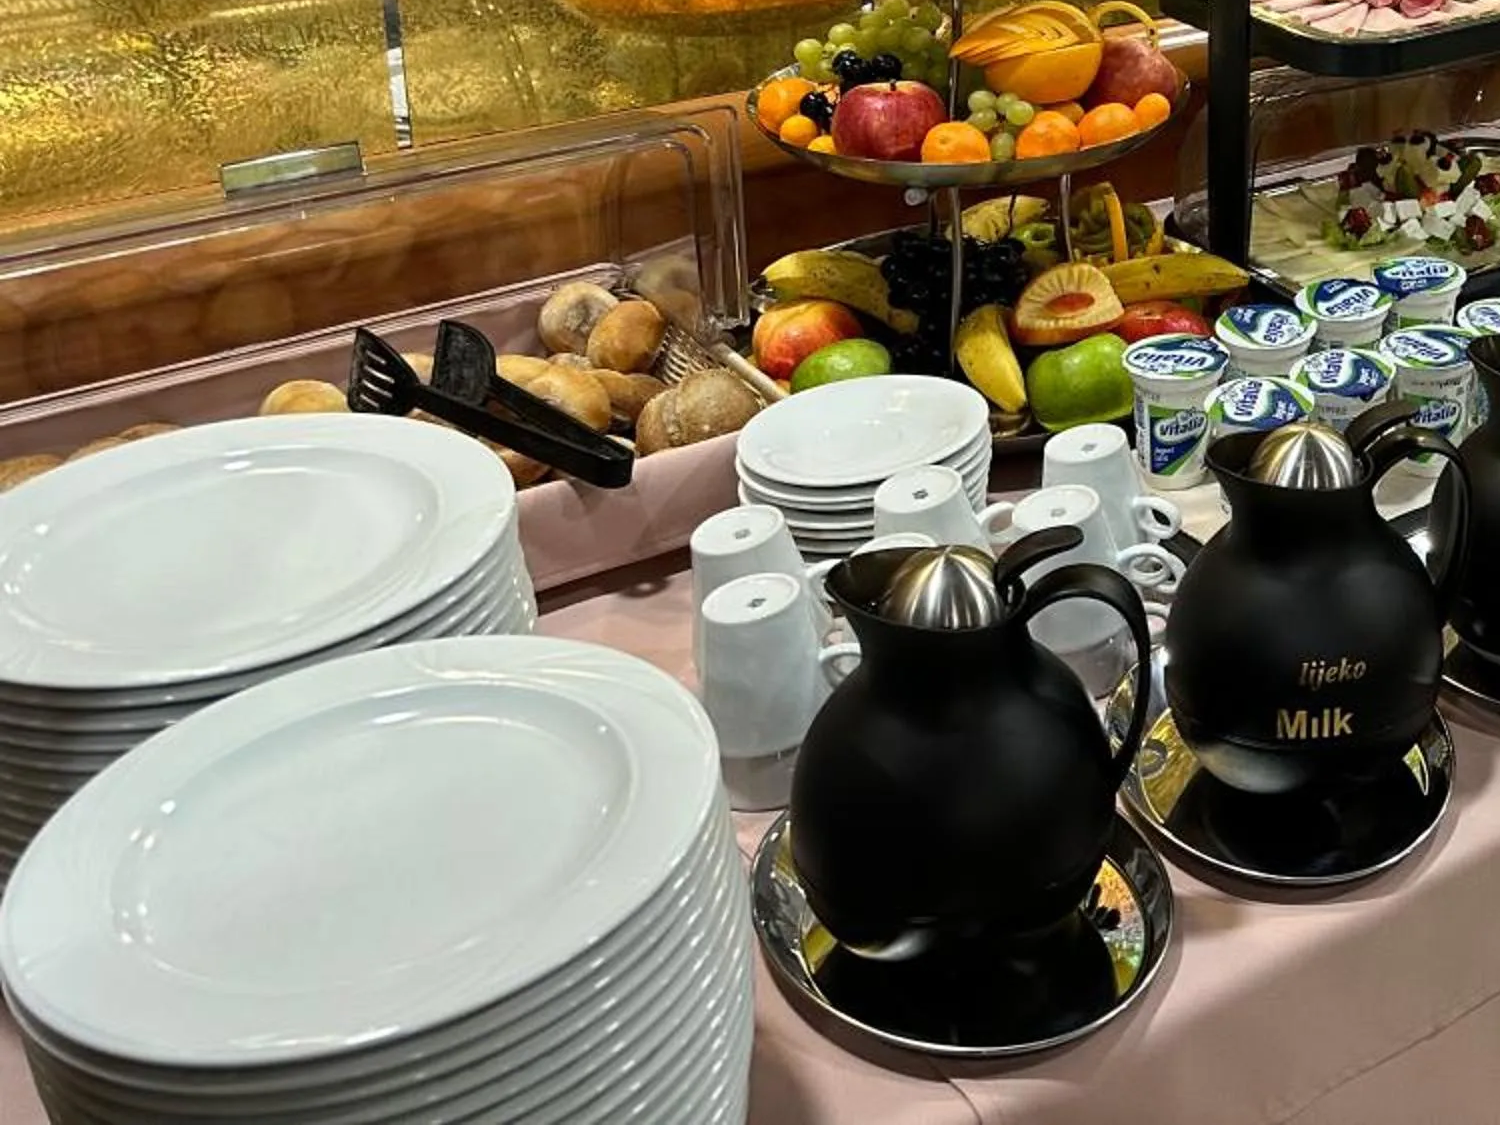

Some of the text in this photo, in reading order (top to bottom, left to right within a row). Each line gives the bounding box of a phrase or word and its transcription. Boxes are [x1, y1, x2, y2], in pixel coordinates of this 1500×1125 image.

[1325, 288, 1376, 317] Vitalia
[1133, 350, 1208, 367] Vitalia
[1319, 350, 1345, 384] Vitalia
[1234, 380, 1263, 417] Vitalia
[1158, 416, 1205, 436] Vitalia
[1276, 707, 1353, 741] Milk
